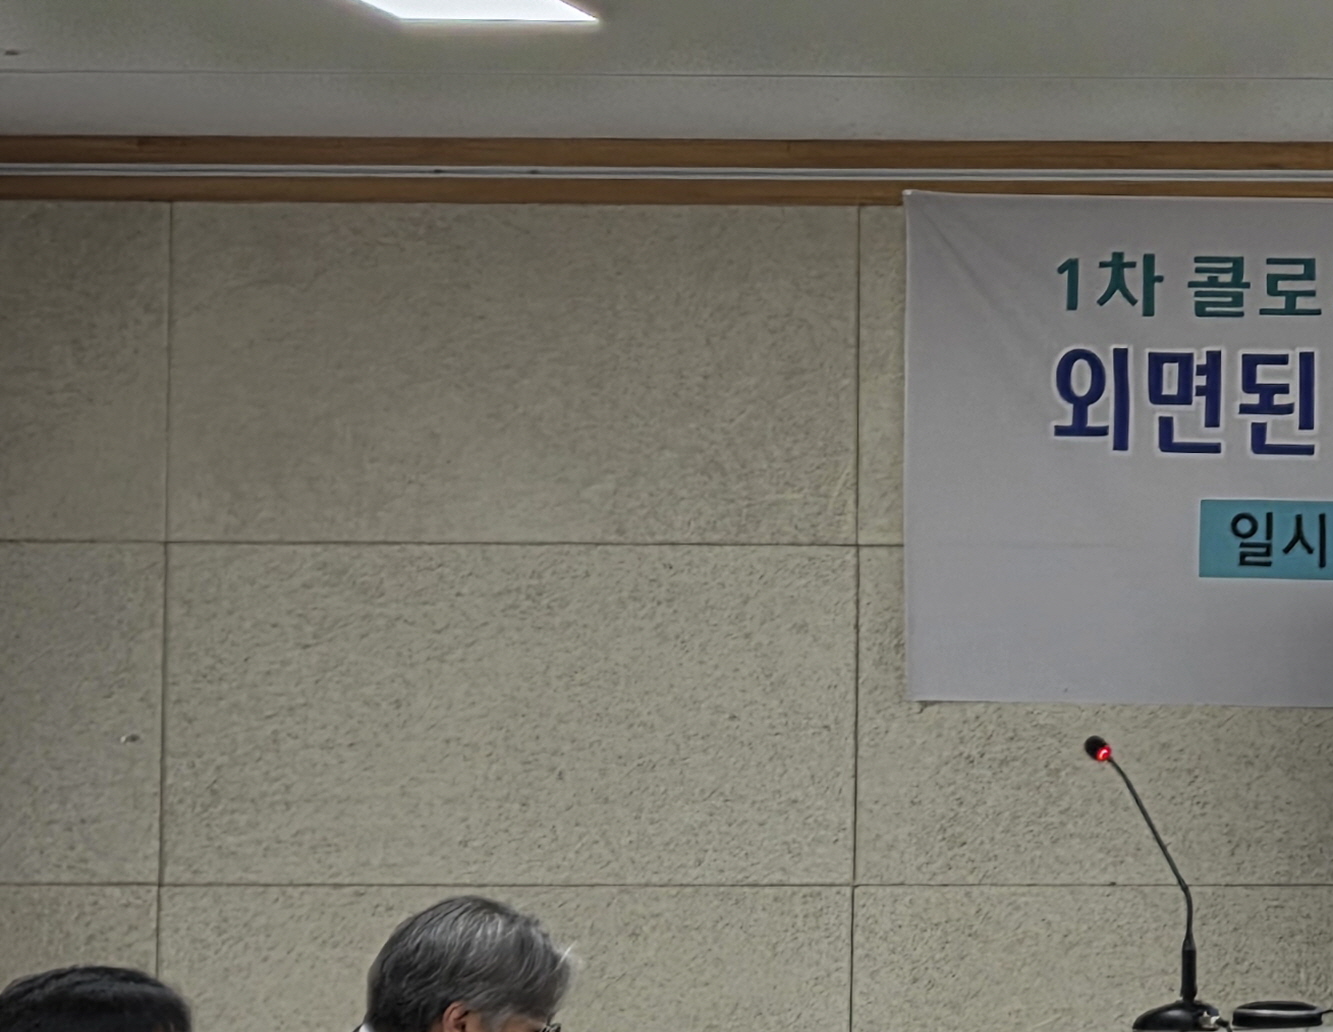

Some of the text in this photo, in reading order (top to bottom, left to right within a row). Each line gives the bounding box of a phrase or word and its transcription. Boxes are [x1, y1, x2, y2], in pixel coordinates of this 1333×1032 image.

[1056, 252, 1163, 317] 1차
[1053, 346, 1316, 456] 외면된
[1230, 512, 1328, 568] 일시
